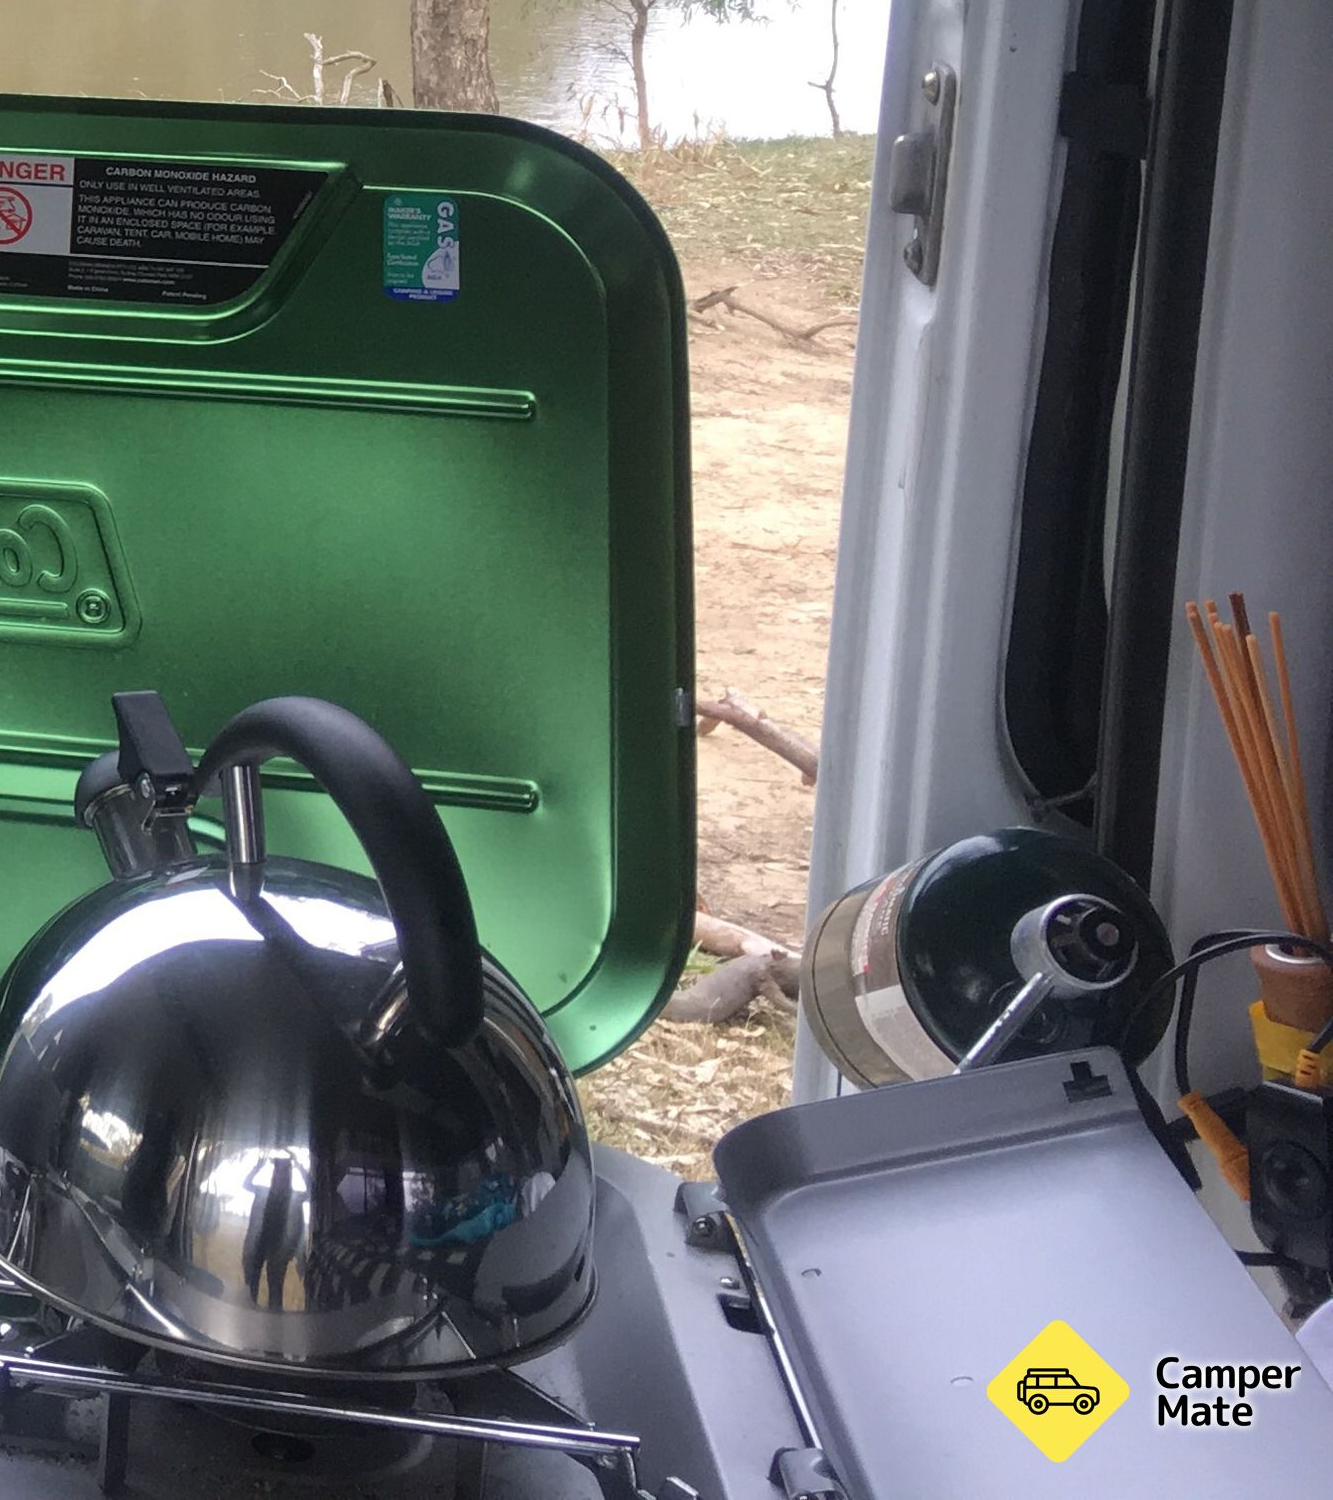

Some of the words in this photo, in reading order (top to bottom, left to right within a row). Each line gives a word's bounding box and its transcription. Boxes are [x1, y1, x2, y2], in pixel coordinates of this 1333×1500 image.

[106, 167, 151, 178] CARBON
[154, 169, 209, 181] MONOXIDE
[212, 172, 256, 183] HAZARD
[79, 180, 104, 189] ONLY
[106, 181, 125, 190] USE
[128, 183, 138, 191] IN
[140, 183, 165, 192] WELL
[167, 184, 225, 196] VENTILATED
[79, 194, 101, 204] THIS
[102, 196, 155, 206] APPLIANCE
[157, 199, 178, 208] CAN
[180, 200, 228, 211] PRODUCE
[230, 203, 272, 213] CARBON
[77, 215, 86, 223] IT
[100, 217, 114, 225] AN
[116, 217, 169, 229] ENCLOSED
[171, 220, 202, 231] SPACE
[133, 208, 166, 217] WHICH
[167, 210, 188, 219] HAS
[189, 211, 205, 220] NO
[206, 212, 243, 222] ODOUR
[244, 214, 275, 225] USING
[437, 201, 454, 249] GAS
[76, 235, 108, 246] CAUSE
[175, 231, 210, 241] MOBILE
[212, 233, 243, 244] HOME)
[244, 235, 265, 245] MAY
